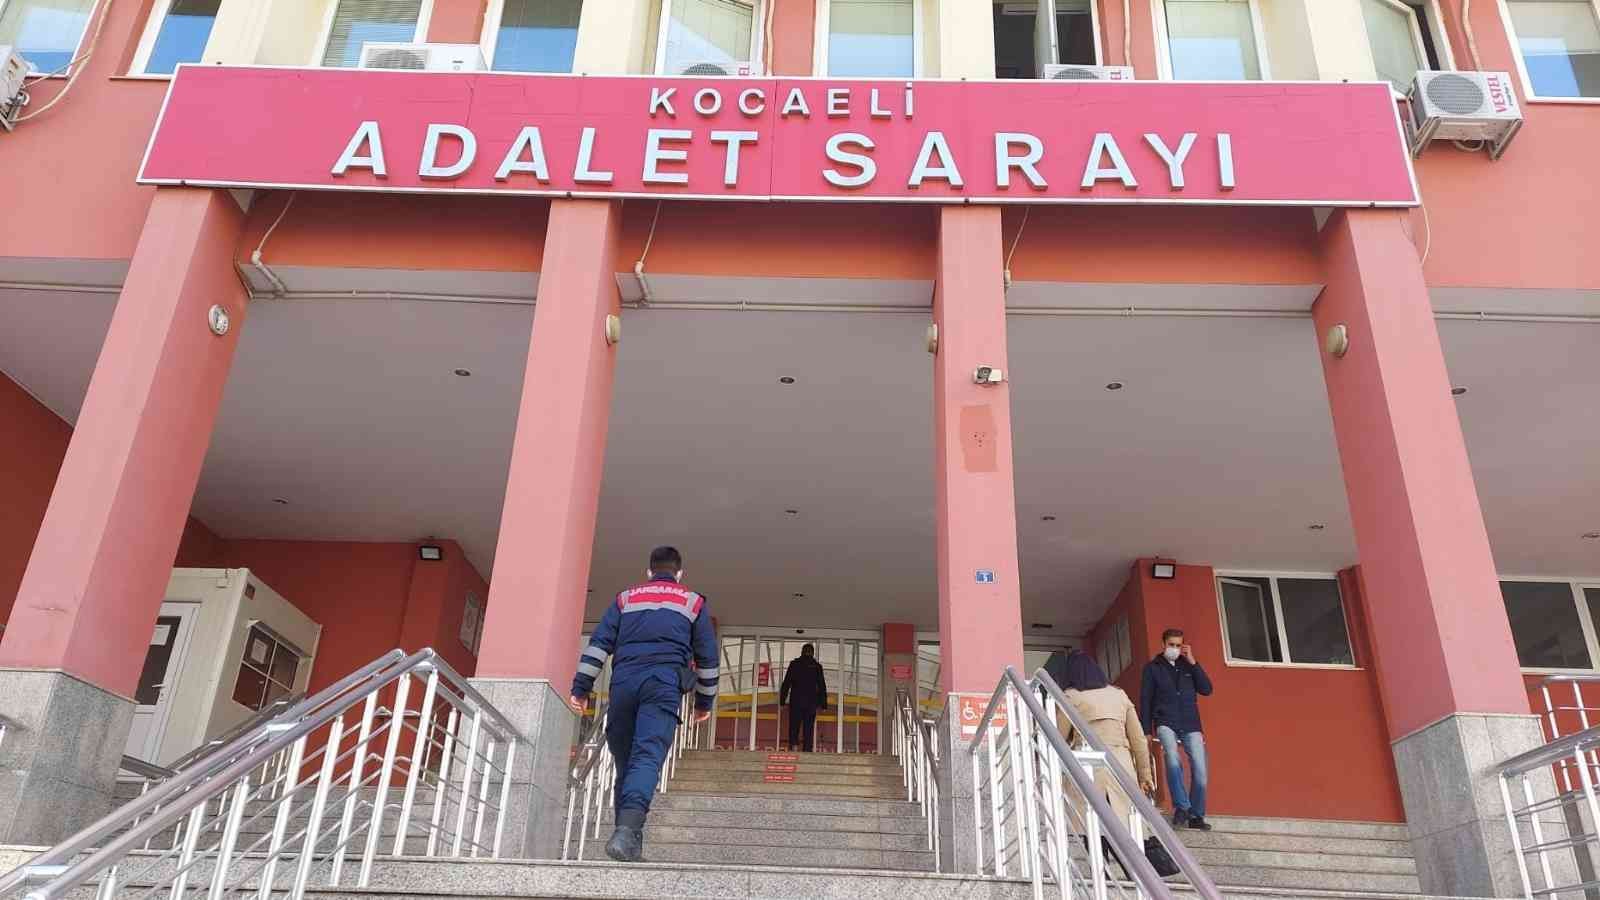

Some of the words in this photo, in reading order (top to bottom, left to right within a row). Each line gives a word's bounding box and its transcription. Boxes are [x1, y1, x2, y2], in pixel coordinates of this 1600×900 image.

[649, 82, 914, 120] KOCAELİ
[1487, 74, 1507, 112] VESTEL
[331, 121, 759, 188] ADALET
[822, 131, 1236, 191] SARAYI
